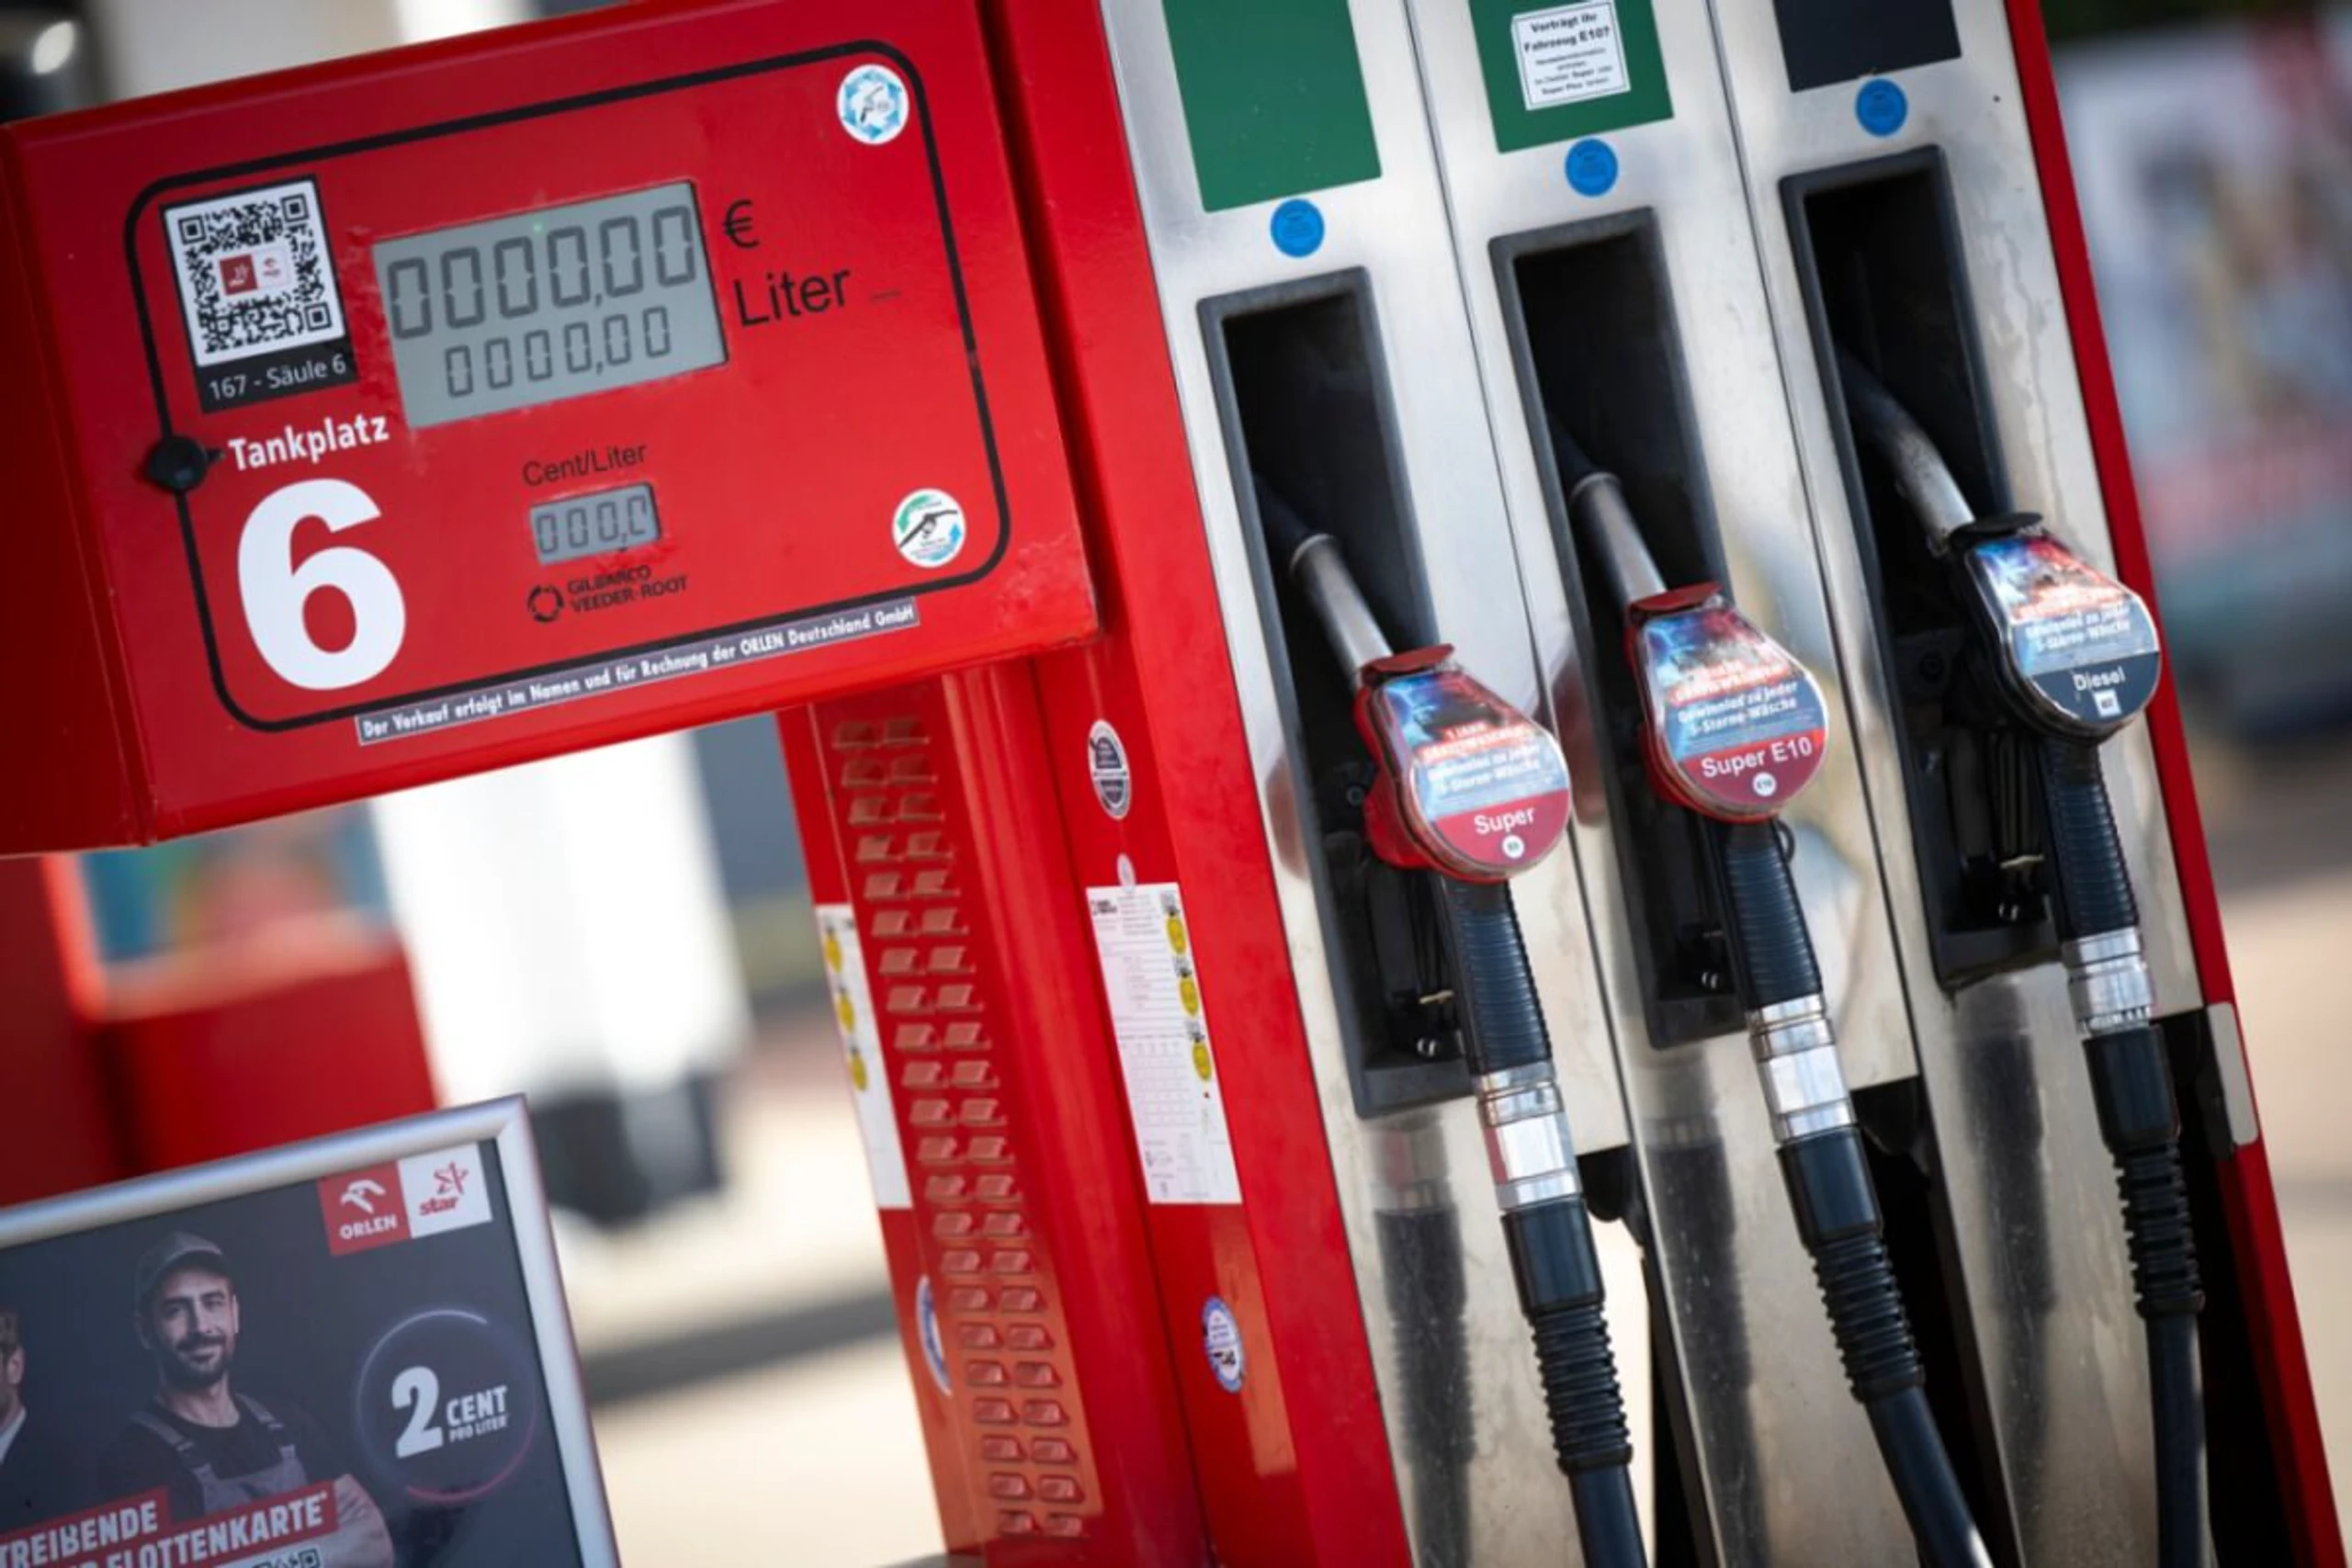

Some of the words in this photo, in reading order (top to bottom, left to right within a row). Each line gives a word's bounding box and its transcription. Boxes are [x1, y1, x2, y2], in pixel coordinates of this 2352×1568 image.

[1581, 13, 1597, 23] Ihr
[1524, 36, 1577, 52] Fahrzeug
[722, 199, 761, 249] €
[387, 205, 698, 341] 0000,00
[734, 268, 851, 328] Liter
[445, 306, 672, 399] 0000,00
[209, 374, 247, 401] 167
[266, 359, 328, 389] Säule
[331, 353, 347, 375] 6
[228, 413, 390, 471] Tankplatz
[522, 445, 648, 487] Cent/Liter
[237, 477, 406, 691] 6
[362, 720, 389, 739] Der
[392, 707, 448, 732] Verkauf
[454, 693, 503, 716] erfolgt
[508, 691, 526, 706] im
[530, 679, 581, 703] Namen
[584, 667, 611, 690] und
[616, 663, 637, 683] für
[640, 651, 709, 678] Rechnung
[712, 645, 737, 661] der
[741, 631, 785, 656] ORLEN
[788, 612, 871, 646] Deutschland
[876, 603, 915, 627] GmbH
[2073, 665, 2126, 691] Diesel
[1702, 751, 1766, 778] Super
[1771, 736, 1813, 762] E10
[1474, 807, 1535, 835] Super
[339, 1213, 398, 1240] ORLEN
[419, 1196, 458, 1216] star
[391, 1365, 444, 1459] 2
[446, 1383, 508, 1427] CENT
[449, 1425, 474, 1443] PRO
